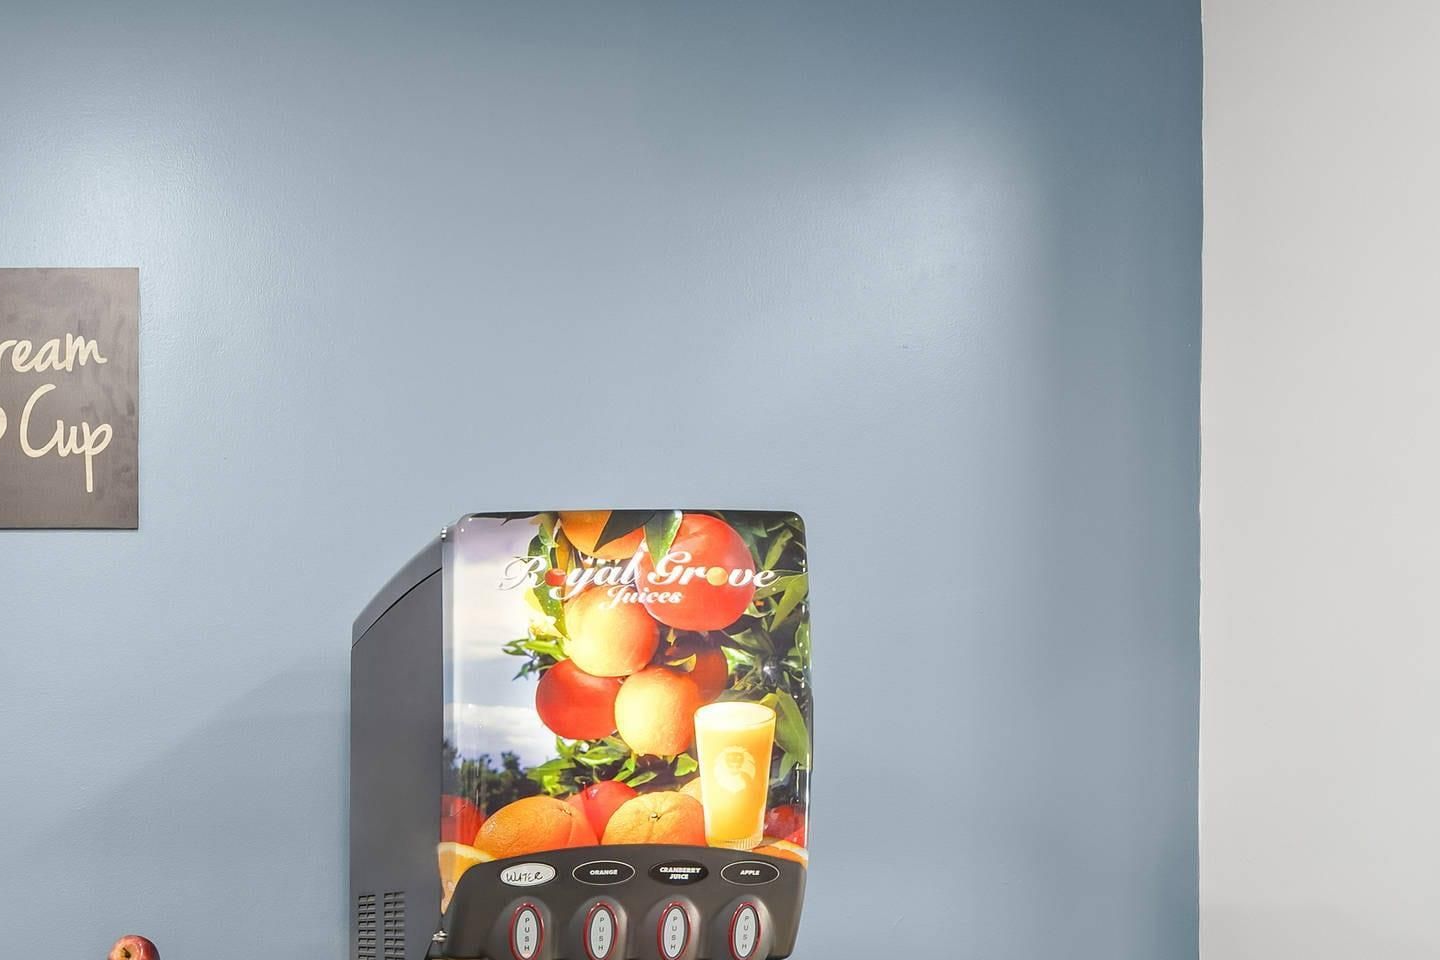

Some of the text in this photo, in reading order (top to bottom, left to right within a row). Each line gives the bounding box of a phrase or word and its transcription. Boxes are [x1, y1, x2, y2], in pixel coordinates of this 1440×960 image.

[19, 383, 113, 493] Cup
[498, 549, 780, 601] Royal Grove
[600, 586, 682, 609] Juices
[670, 915, 678, 950] PUSH
[741, 915, 750, 950] PUSH
